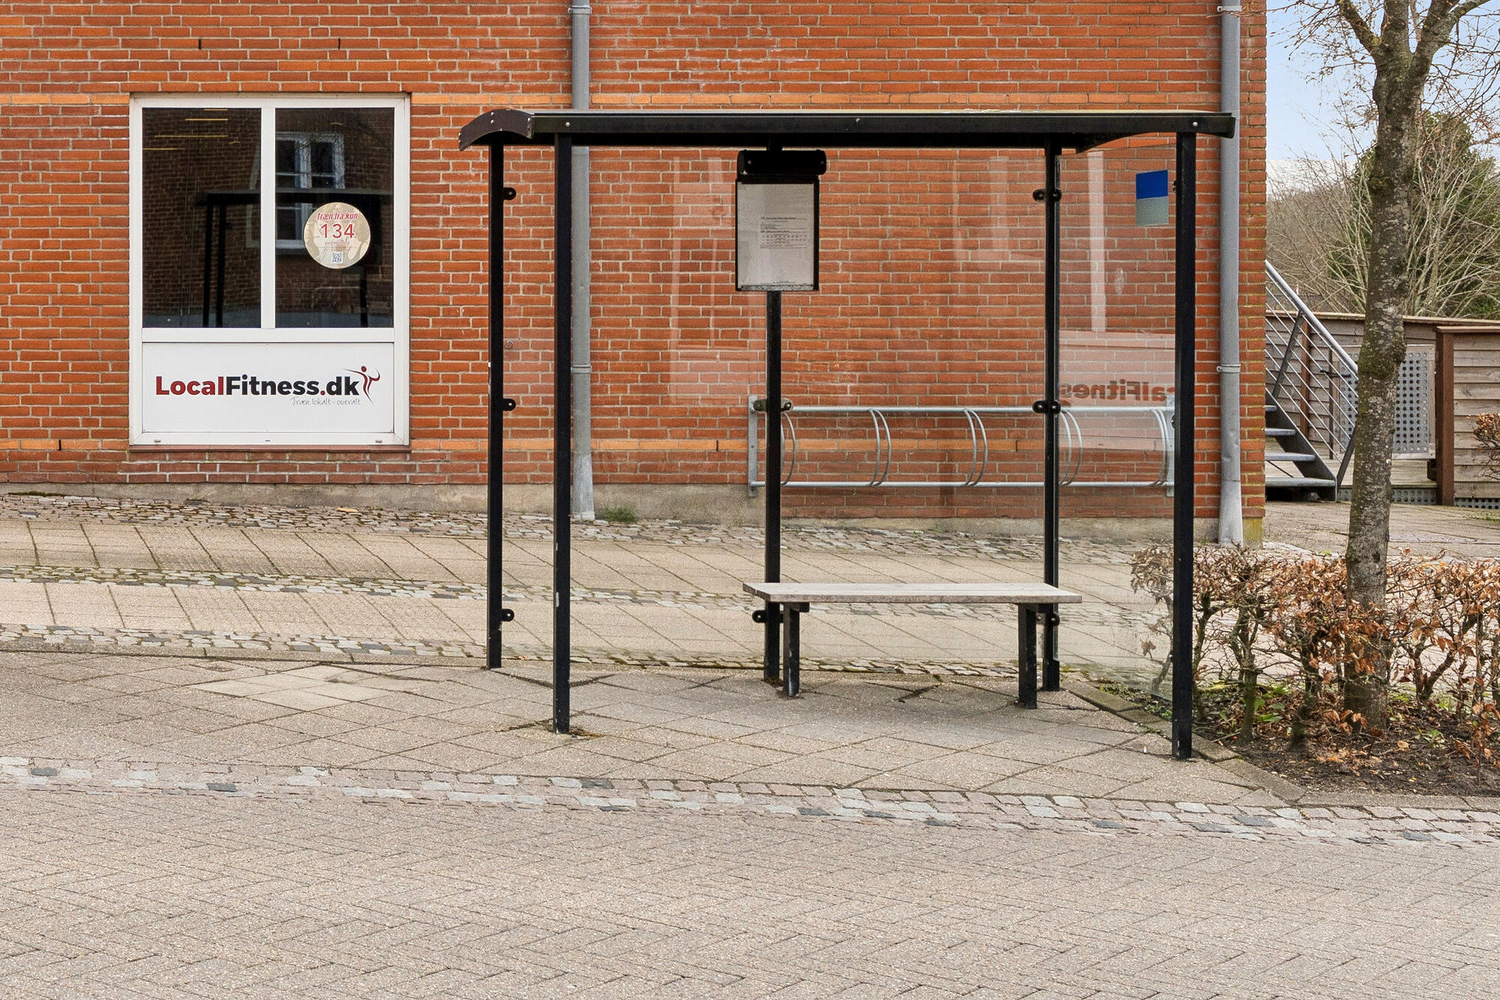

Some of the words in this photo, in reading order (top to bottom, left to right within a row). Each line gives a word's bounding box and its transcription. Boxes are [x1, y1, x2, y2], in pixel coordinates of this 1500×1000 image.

[320, 223, 355, 239] 134
[156, 374, 360, 396] LocalFitness.dk
[312, 397, 331, 406] lokalt
